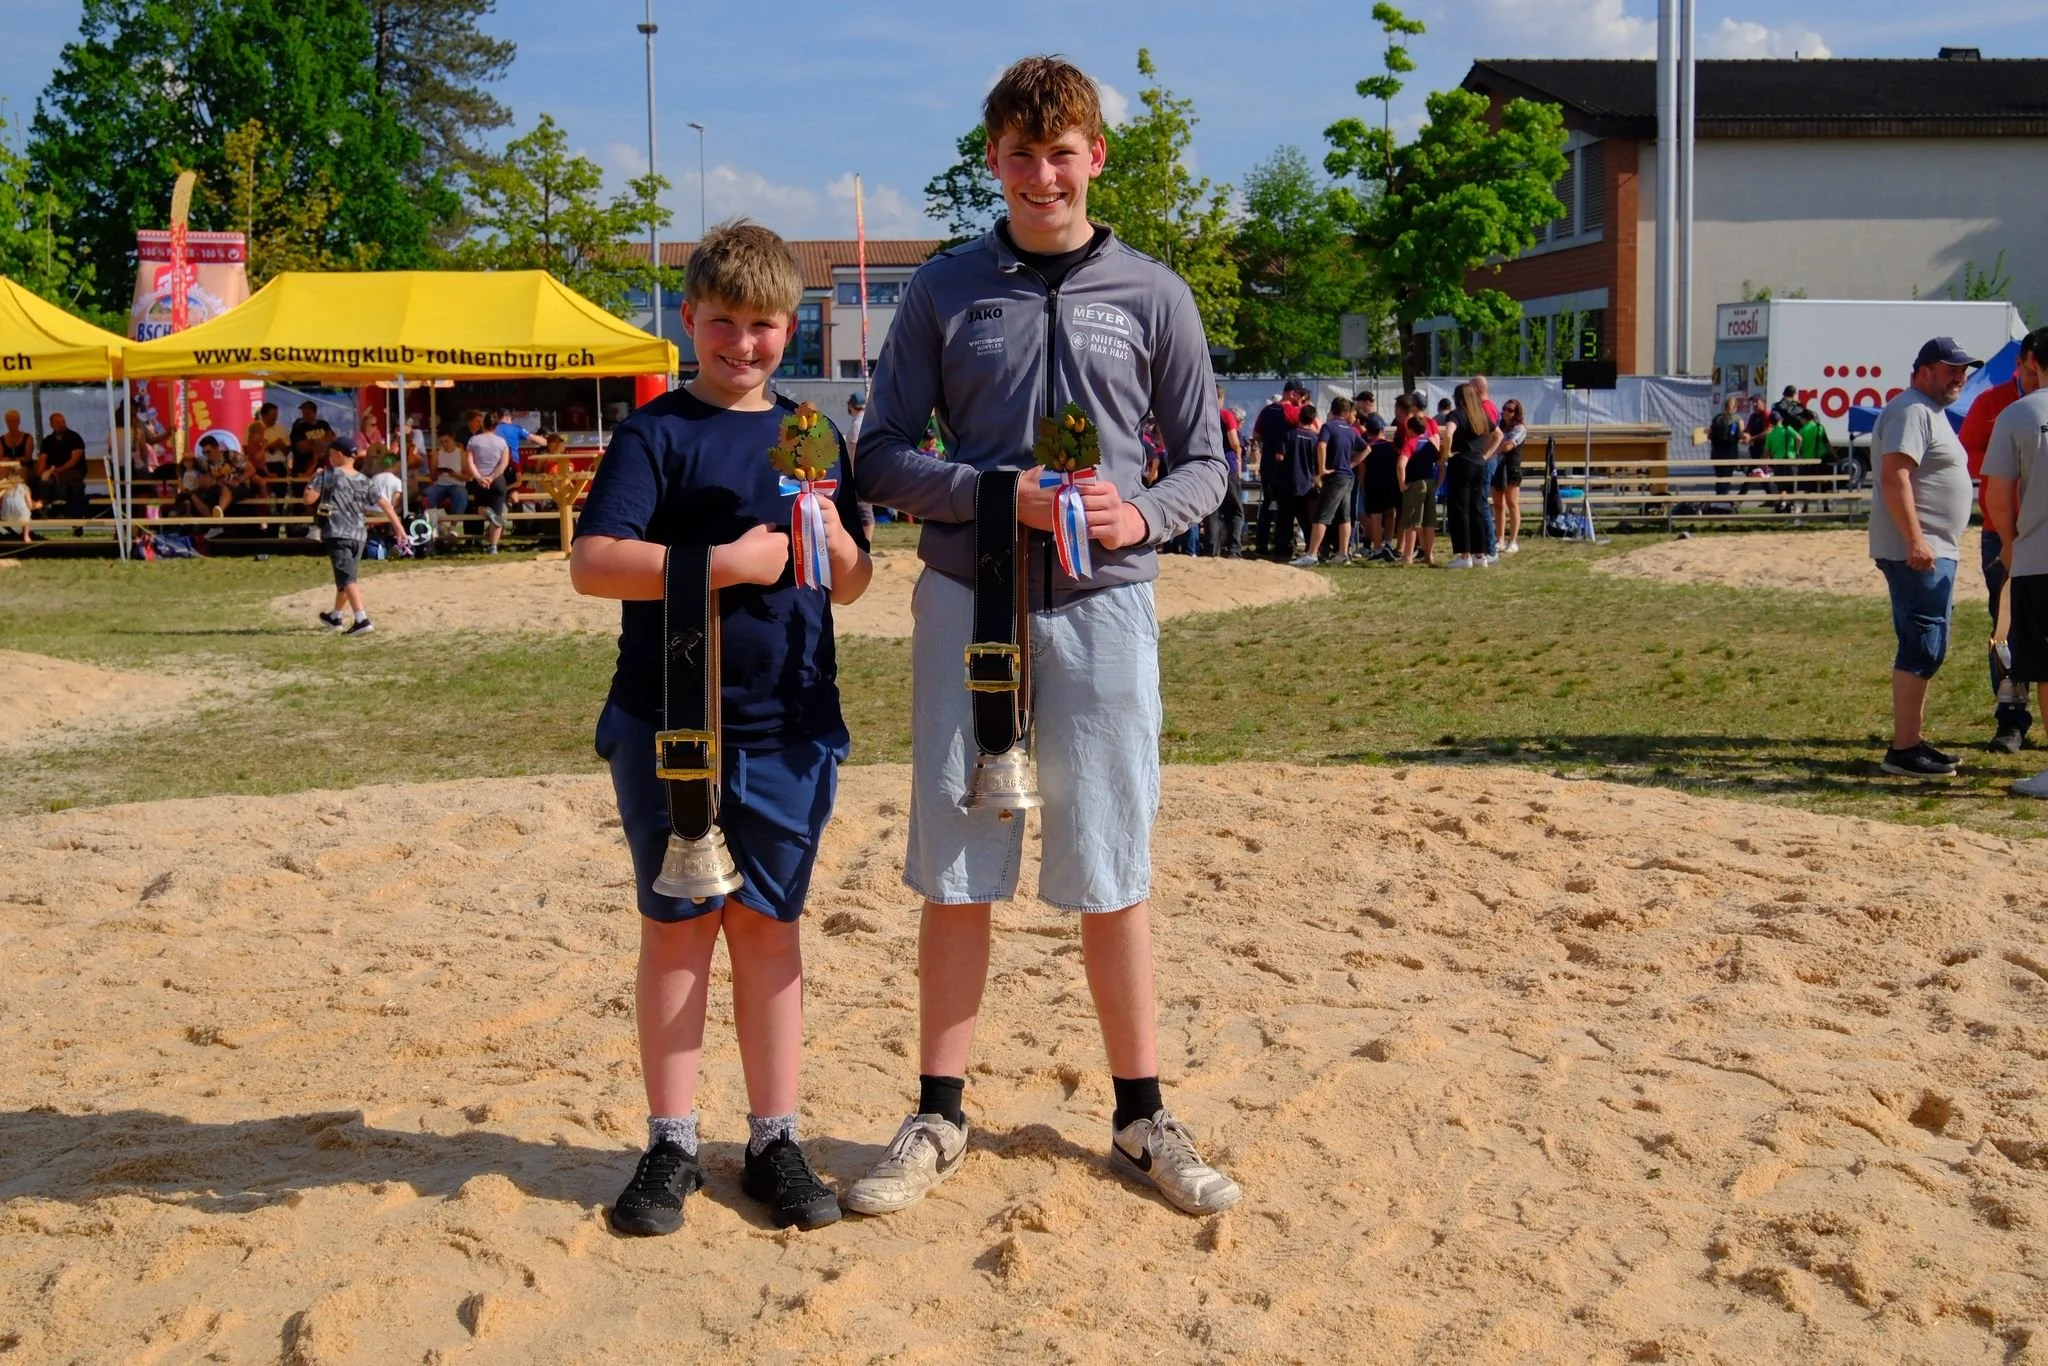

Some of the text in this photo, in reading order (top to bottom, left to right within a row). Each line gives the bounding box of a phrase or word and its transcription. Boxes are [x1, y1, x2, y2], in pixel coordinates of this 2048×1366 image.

[968, 307, 1003, 324] JAKO
[1073, 307, 1125, 326] MEYER
[1091, 333, 1130, 351] Nilfisk
[193, 345, 595, 371] www.schwingklub-rothenburg.ch
[1090, 343, 1128, 360] MAX HAAS
